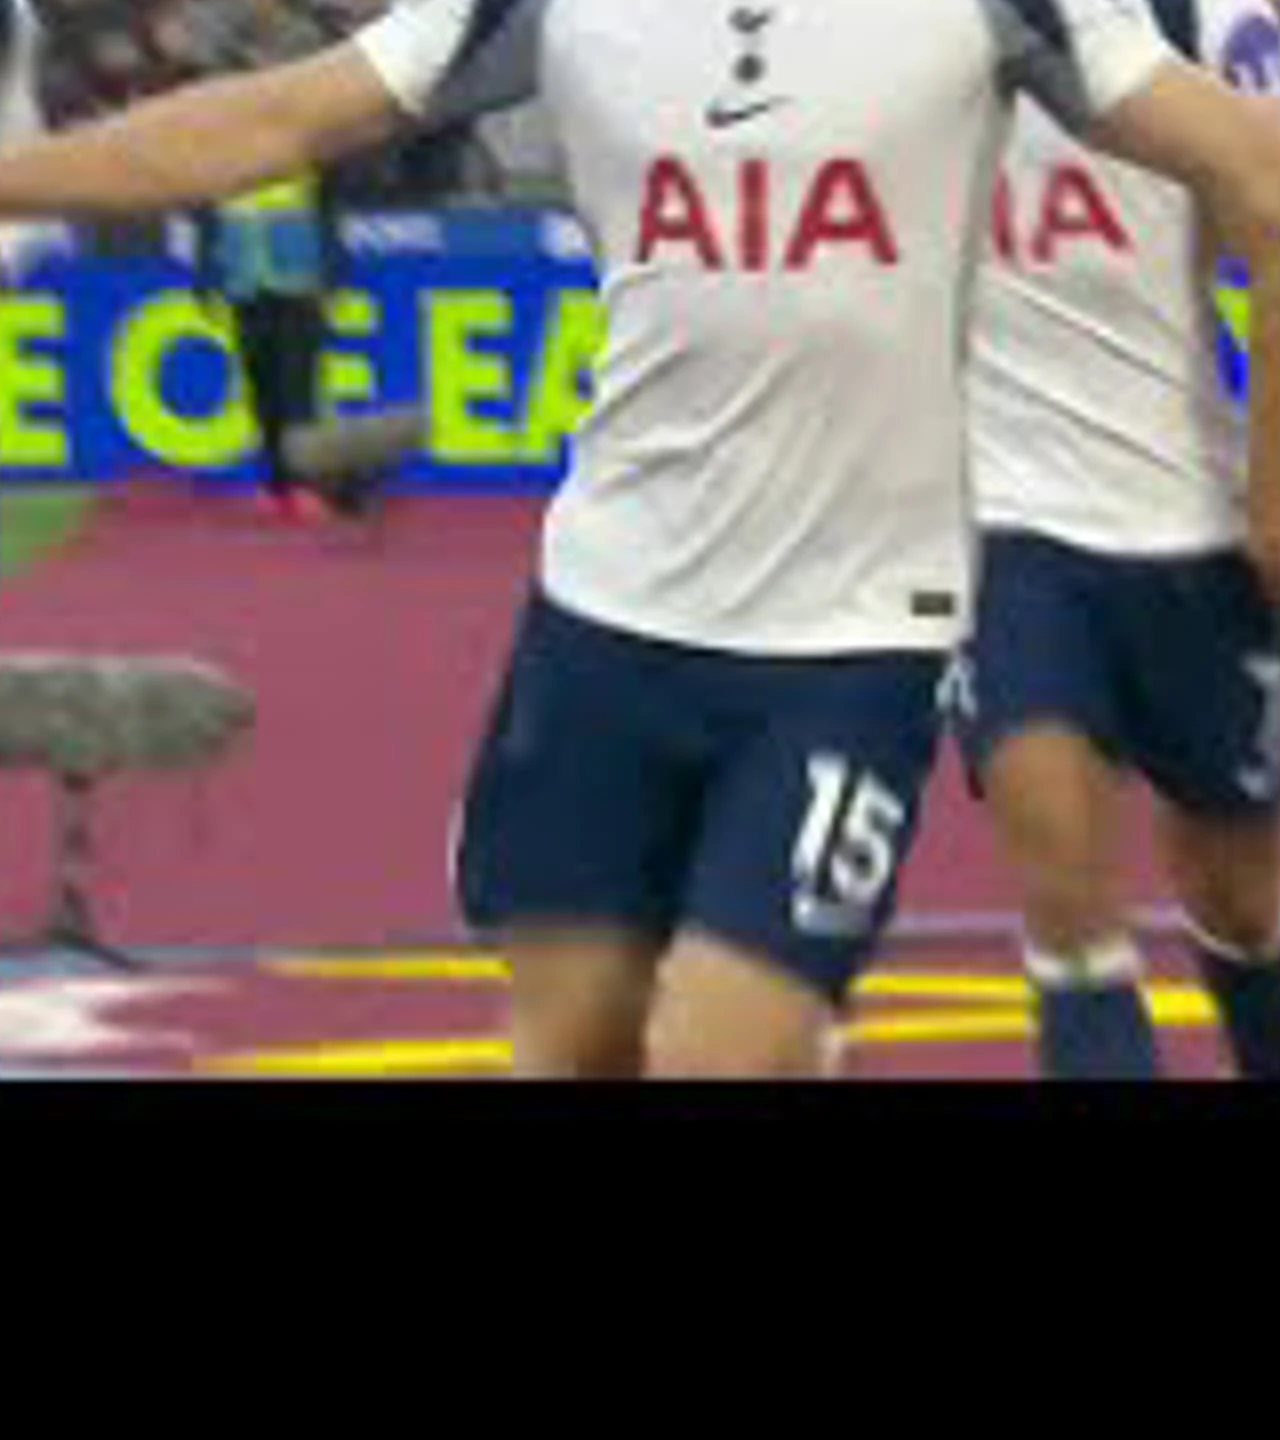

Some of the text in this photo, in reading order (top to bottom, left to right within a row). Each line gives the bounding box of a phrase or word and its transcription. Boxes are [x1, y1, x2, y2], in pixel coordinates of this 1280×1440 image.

[634, 156, 902, 272] AIA
[990, 160, 1136, 267] IA
[790, 752, 906, 904] 15
